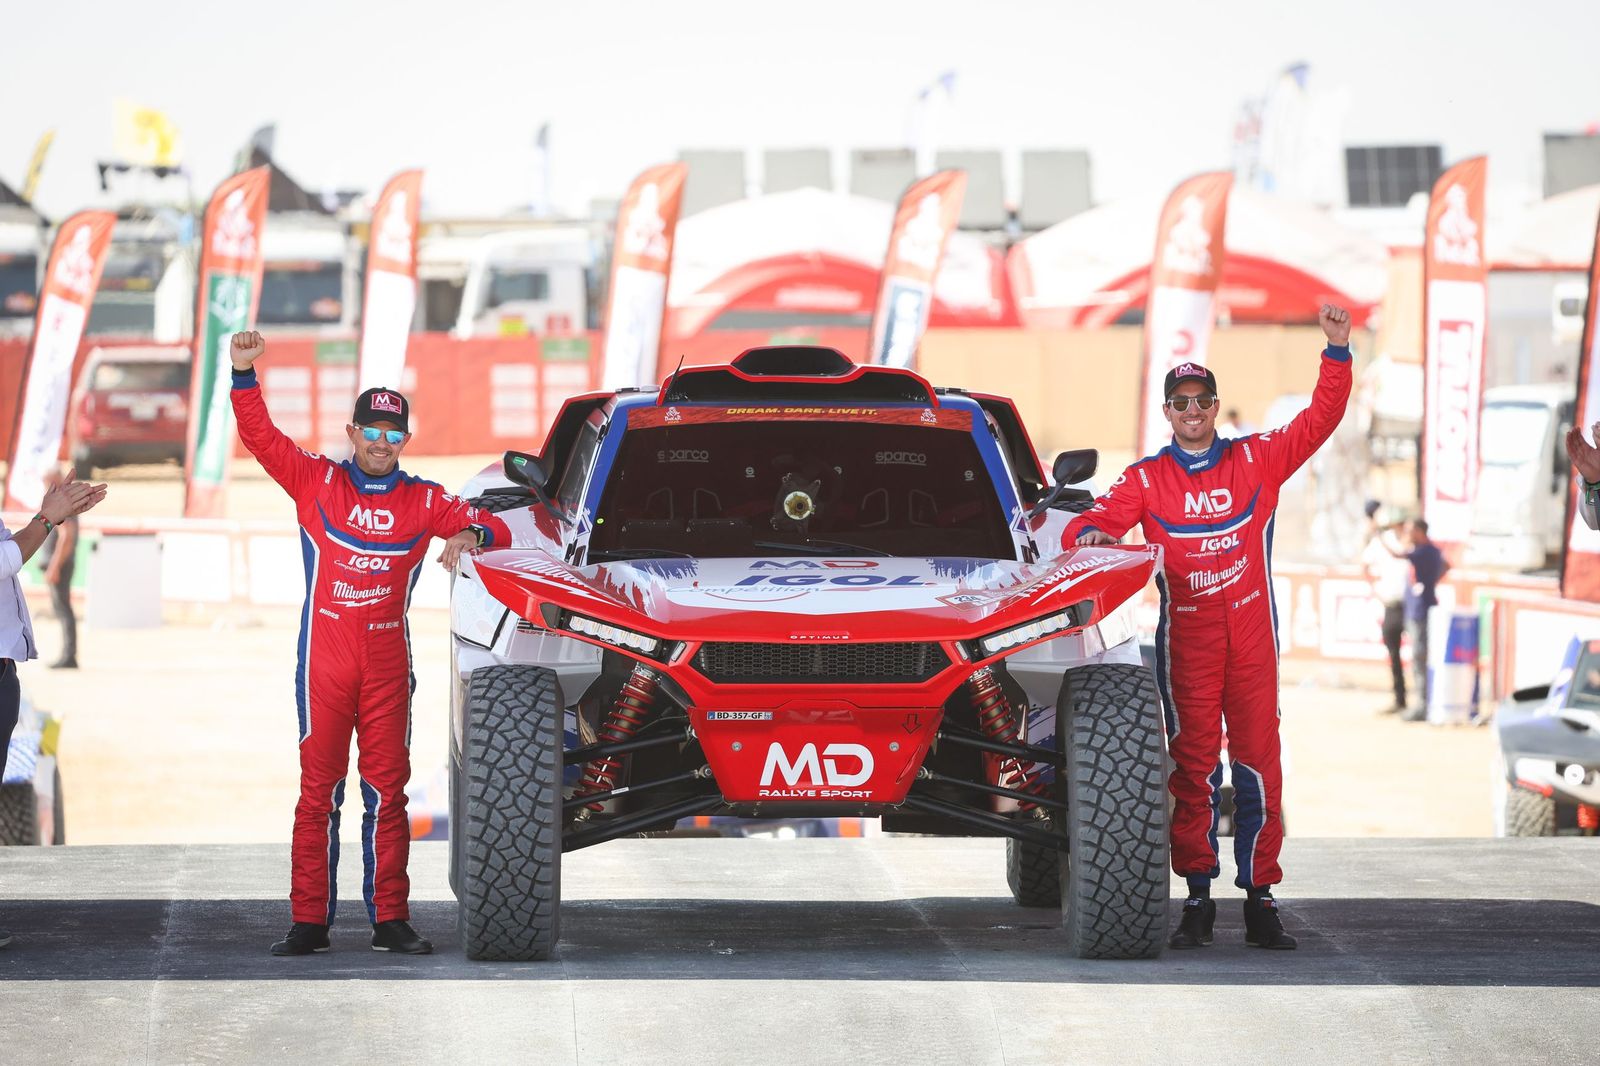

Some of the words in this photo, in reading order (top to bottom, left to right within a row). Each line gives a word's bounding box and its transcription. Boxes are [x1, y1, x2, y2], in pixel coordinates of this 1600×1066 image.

[727, 407, 781, 415] DREAM.
[875, 450, 927, 465] sparco
[1184, 488, 1233, 515] MD
[347, 503, 395, 531] MD
[1200, 532, 1240, 552] IGOL
[347, 553, 391, 572] IGOL
[749, 560, 880, 570] MD
[735, 574, 925, 587] IGOL
[331, 579, 393, 600] Milwaukee
[716, 711, 763, 720] BD-357-GF
[759, 741, 875, 787] MD
[759, 789, 816, 798] RALLYE
[820, 789, 873, 798] SPORT
